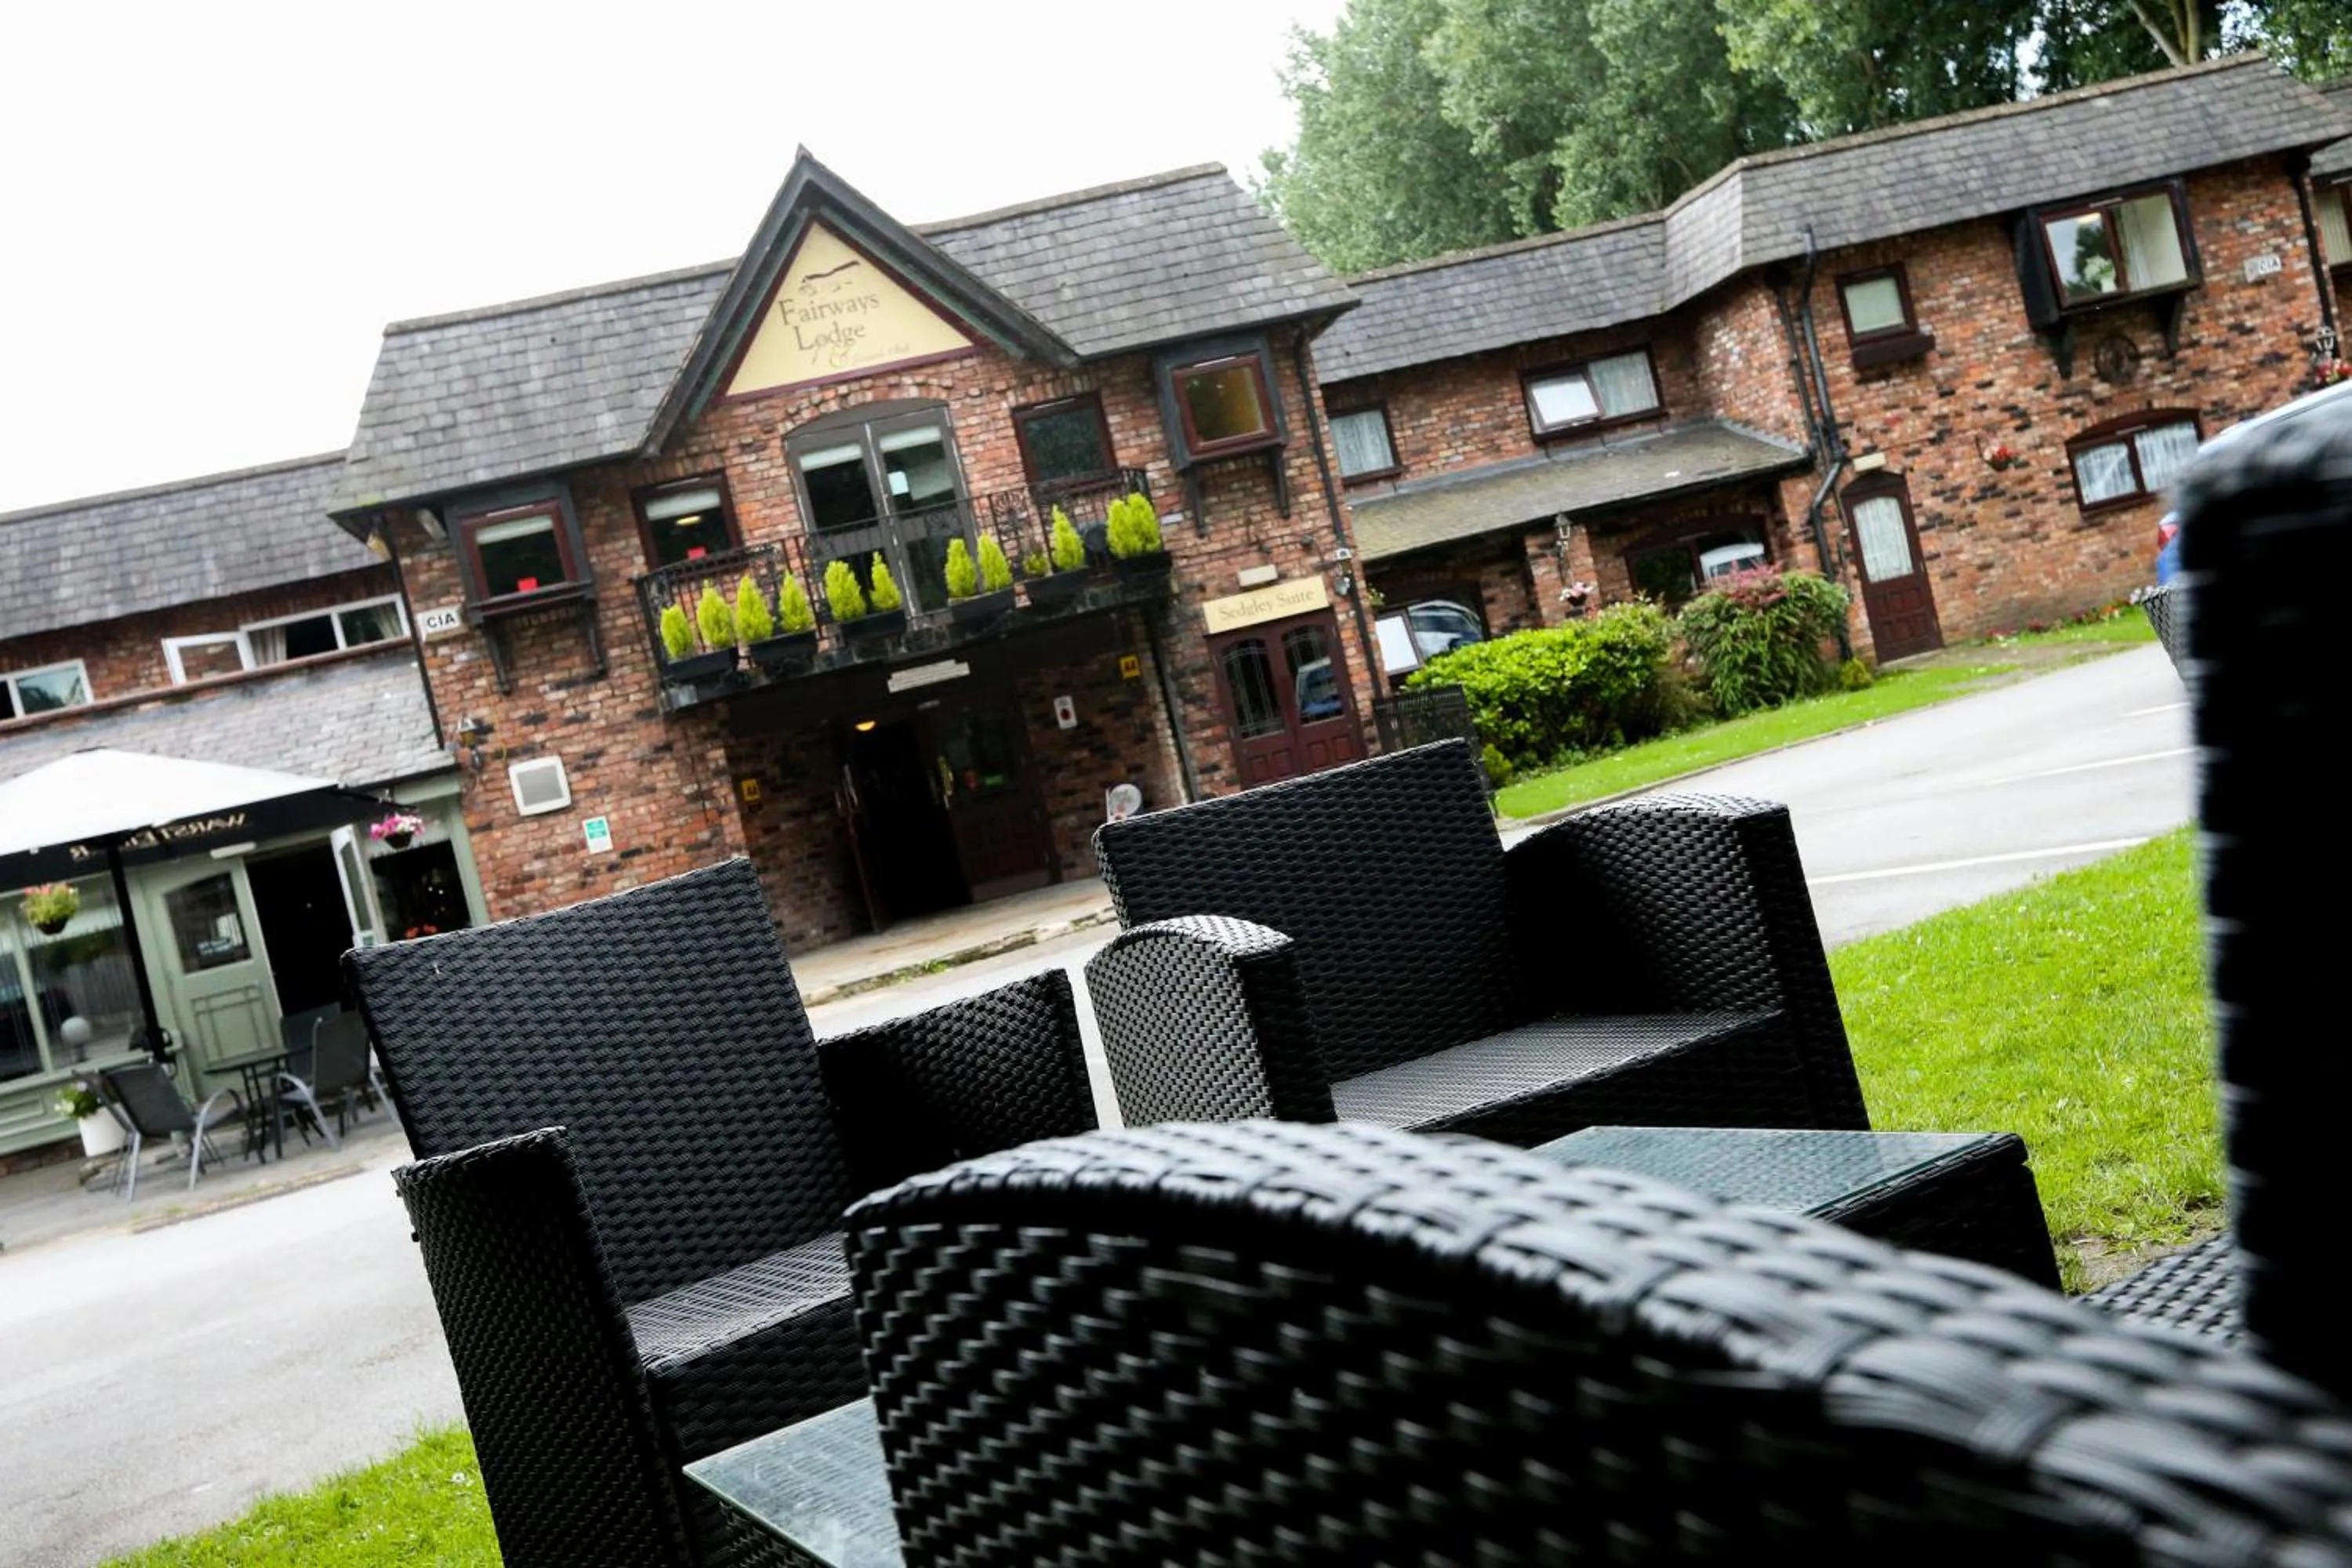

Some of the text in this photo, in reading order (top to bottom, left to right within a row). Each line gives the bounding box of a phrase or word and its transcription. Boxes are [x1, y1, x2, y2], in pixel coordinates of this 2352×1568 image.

[778, 294, 879, 325] Fairways
[793, 320, 866, 350] Lodge
[1276, 591, 1314, 608] Suite
[426, 613, 456, 628] CIA
